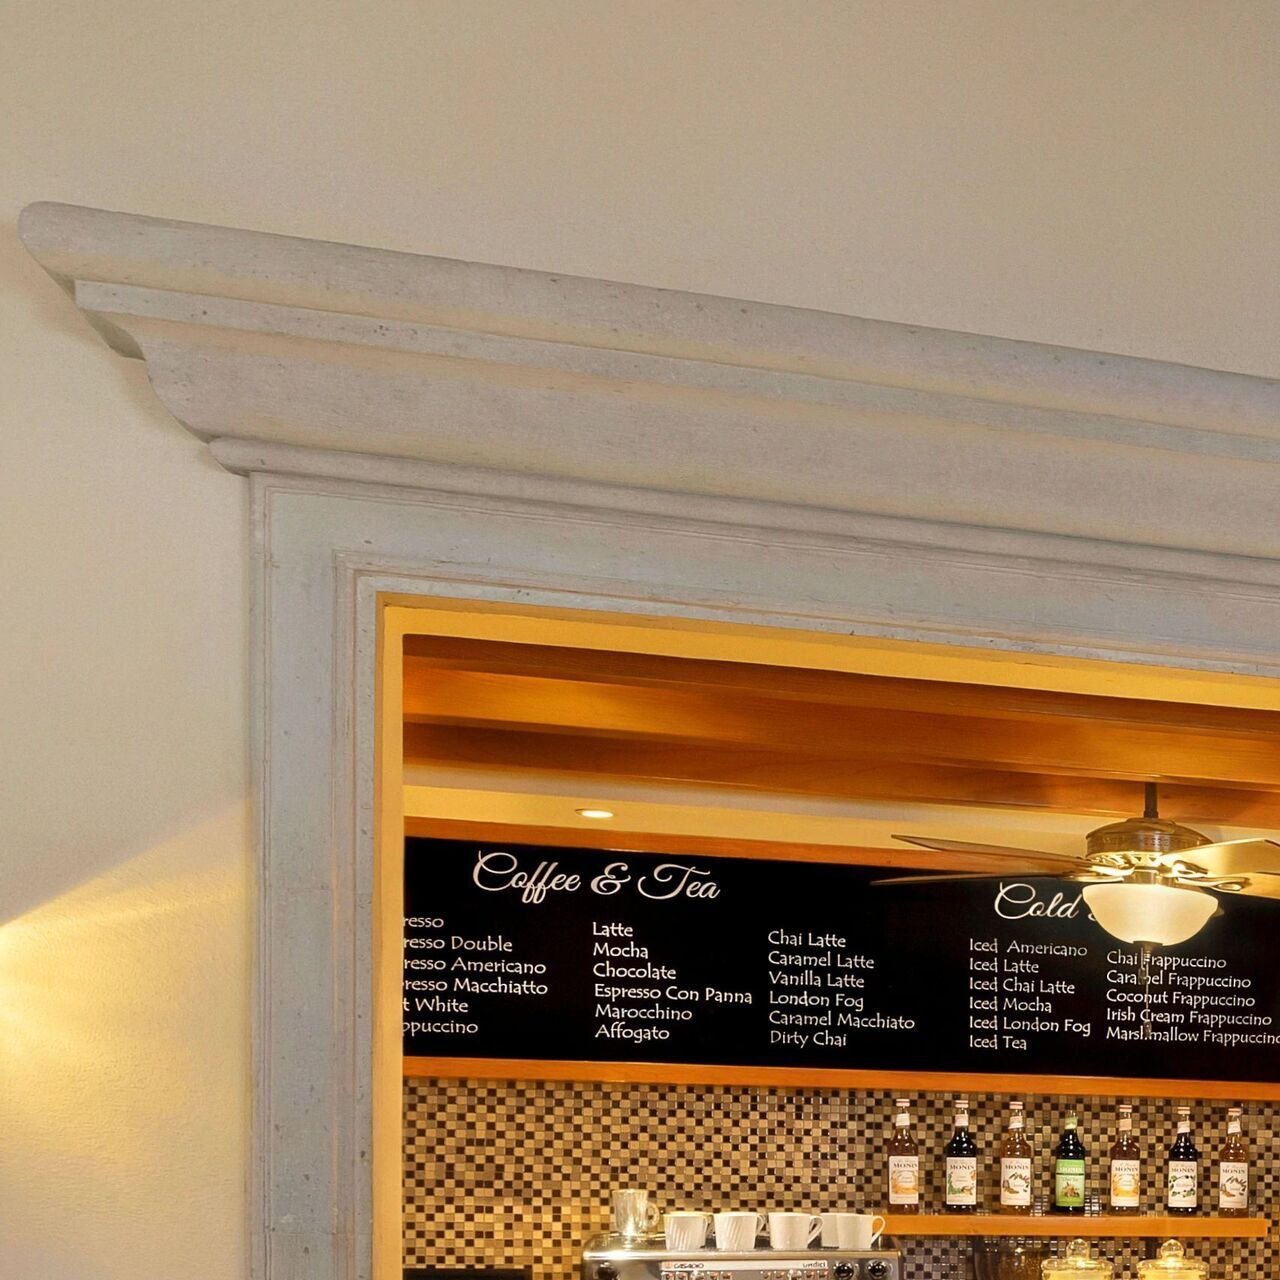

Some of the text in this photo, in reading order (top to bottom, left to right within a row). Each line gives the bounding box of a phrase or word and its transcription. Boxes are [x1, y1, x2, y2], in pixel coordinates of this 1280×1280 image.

[473, 850, 721, 904] Coffee & Tea
[994, 882, 1082, 919] Cold
[404, 917, 444, 928] resso
[593, 922, 633, 937] Latte
[404, 936, 512, 952] resso Double
[768, 930, 846, 948] Chai Latte
[970, 938, 1087, 956] Iced Americano
[593, 942, 648, 959] Mocha
[1107, 949, 1137, 965] Chai
[404, 957, 546, 974] resso Americano
[768, 951, 874, 968] Caramel Latte
[970, 958, 1039, 973] Iced Latte
[593, 962, 676, 980] Chocolate
[769, 970, 864, 988] Vanilla Latte
[406, 978, 548, 995] resso Macchiatto
[970, 977, 1075, 994] Iced Chai Latte
[1169, 973, 1251, 990] Frappuccino
[595, 984, 752, 1004] Espresso Con Panna
[770, 991, 863, 1011] London Fog
[1106, 989, 1255, 1009] Coconut Frappuccino
[415, 996, 468, 1012] White
[596, 1004, 692, 1020] Marocchino
[970, 996, 1051, 1013] Iced Mocha
[769, 1010, 915, 1029] Caramel Macchiato
[1107, 1006, 1272, 1028] Irish Cream Frappuccino
[403, 1020, 478, 1036] ppuccino
[595, 1023, 669, 1043] Affogato
[970, 1016, 1090, 1036] Iced London Fog
[771, 1030, 846, 1048] Dirty Chai
[970, 1034, 1026, 1050] Iced Tea
